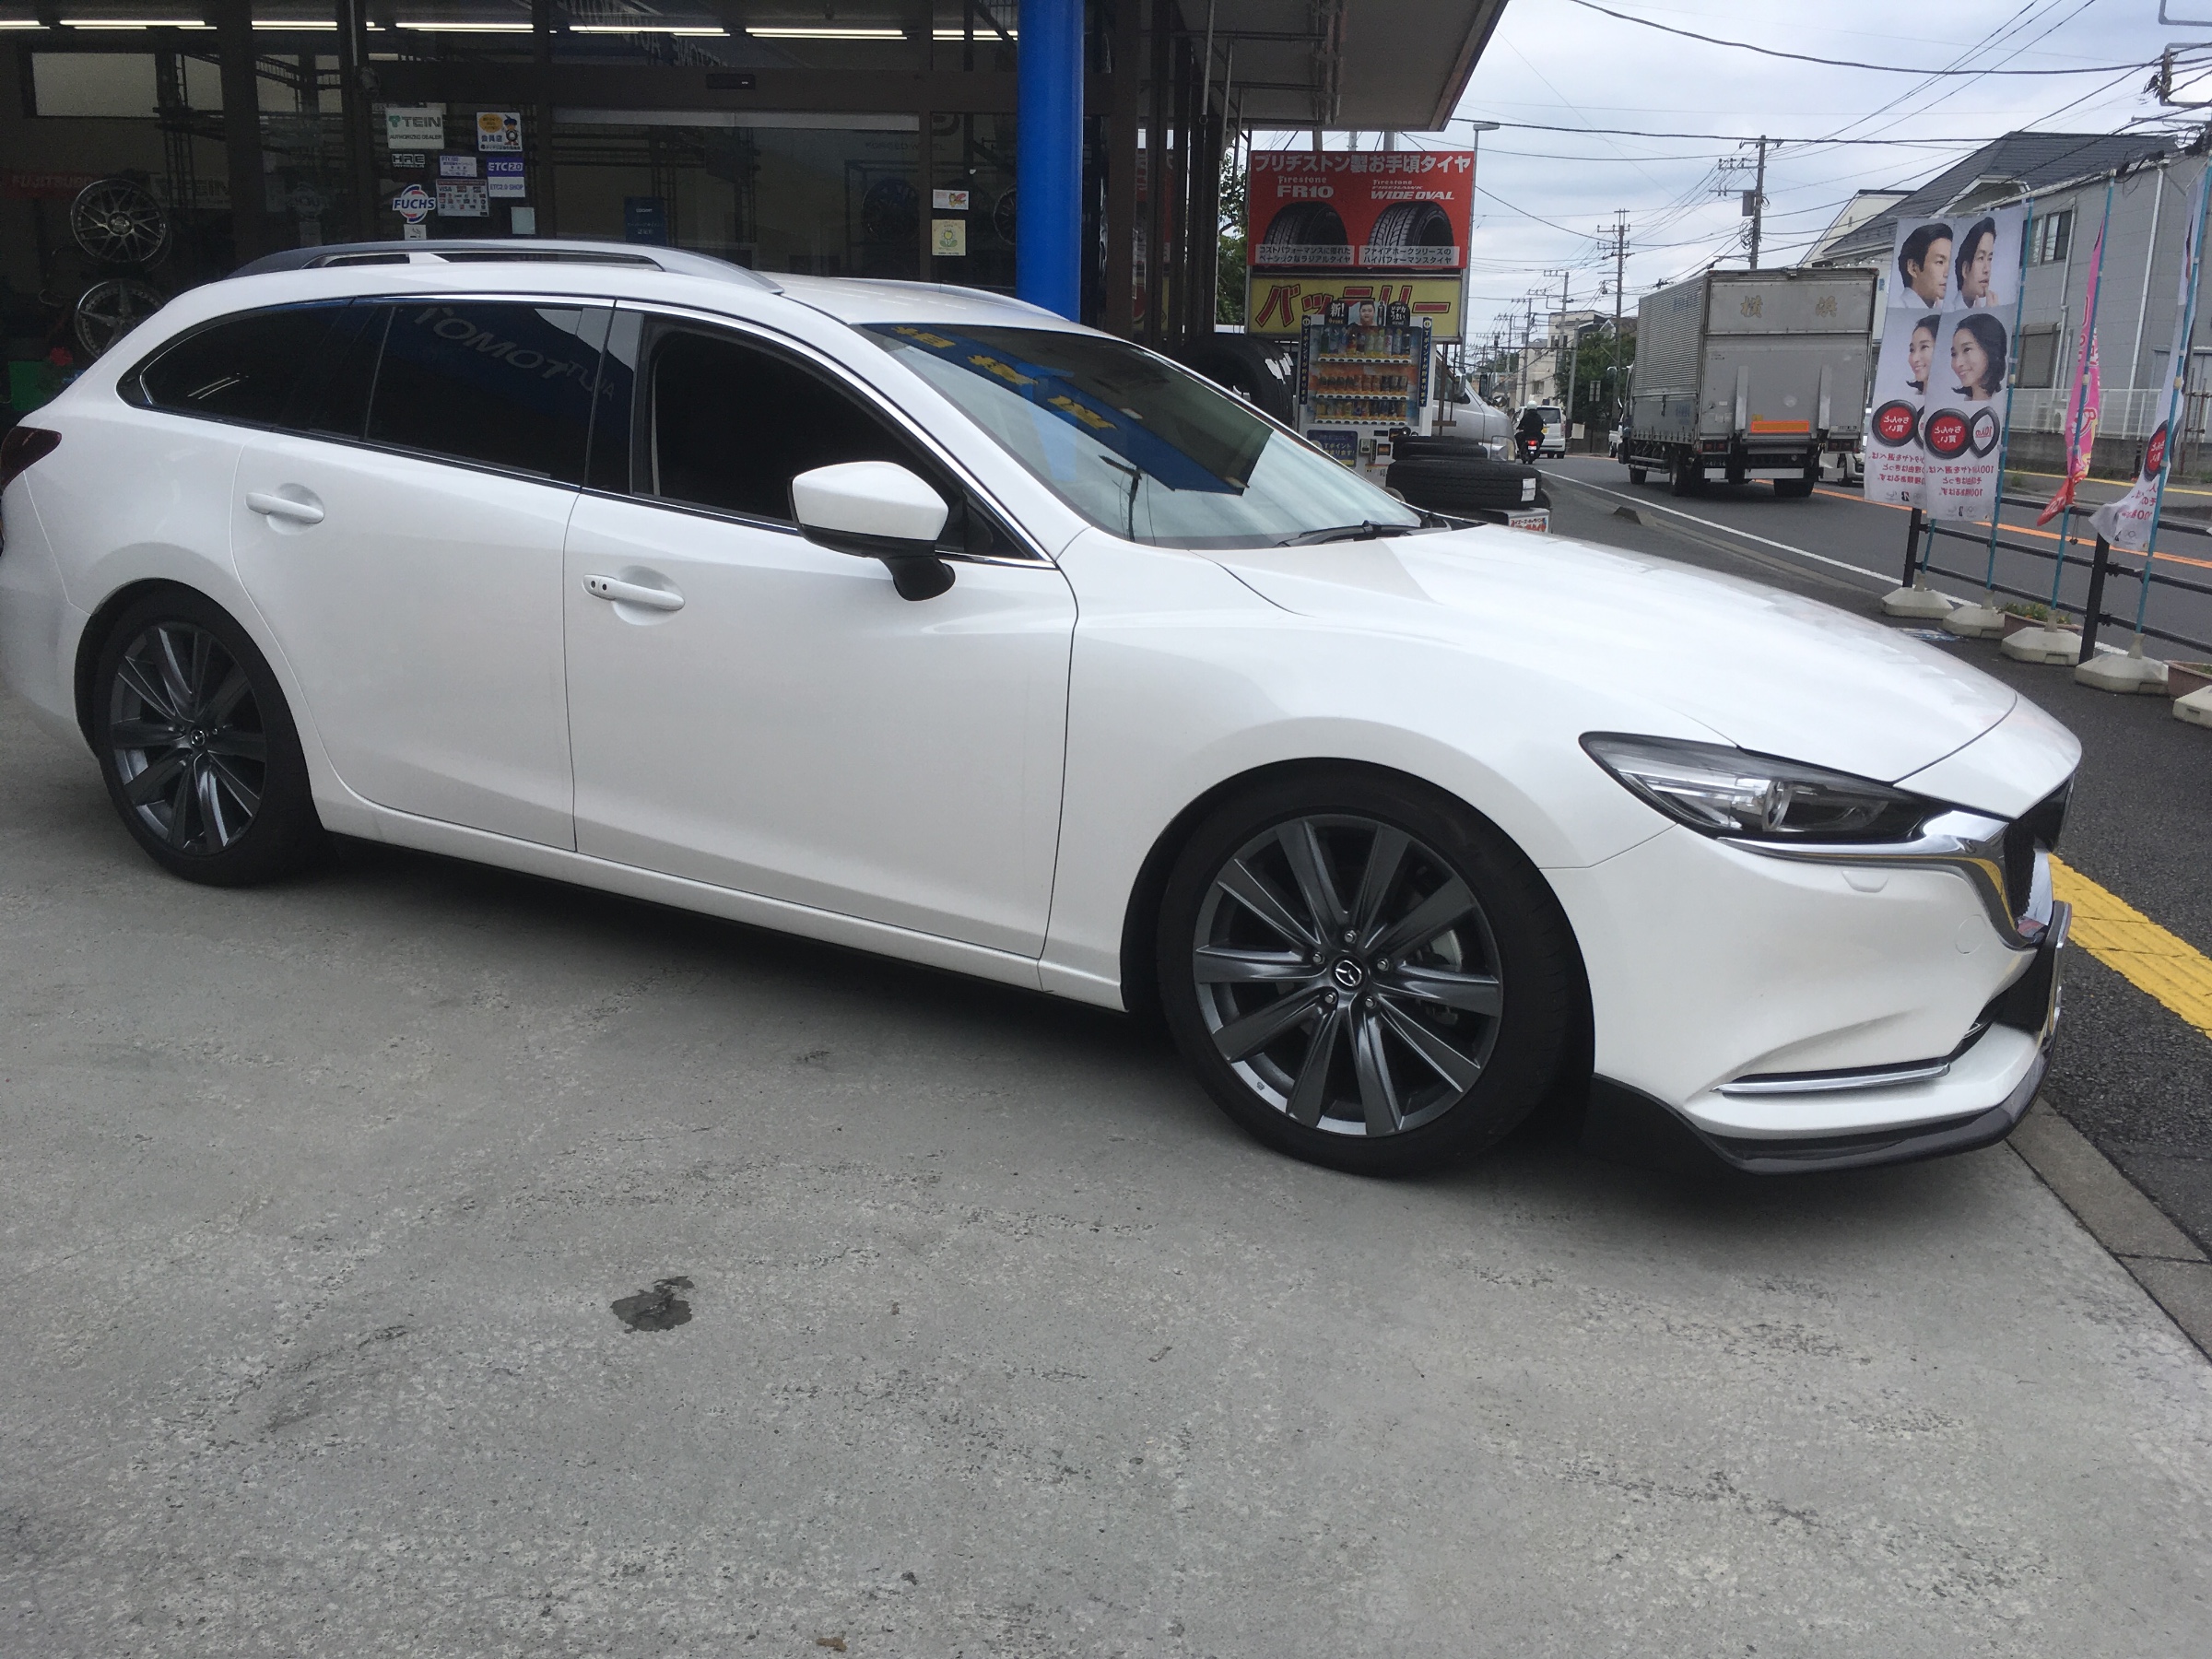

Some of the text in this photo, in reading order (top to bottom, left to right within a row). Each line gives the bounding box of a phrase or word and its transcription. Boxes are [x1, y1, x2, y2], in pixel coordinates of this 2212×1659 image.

[401, 116, 441, 127] TEIN
[392, 153, 425, 165] HRE
[1254, 154, 1471, 174] ブリヂストン製お手頃タイヤ
[1277, 175, 1327, 184] Firestone
[1277, 185, 1334, 198] FR10
[1371, 192, 1454, 200] WIDE OVAL
[394, 198, 435, 209] FUCHS
